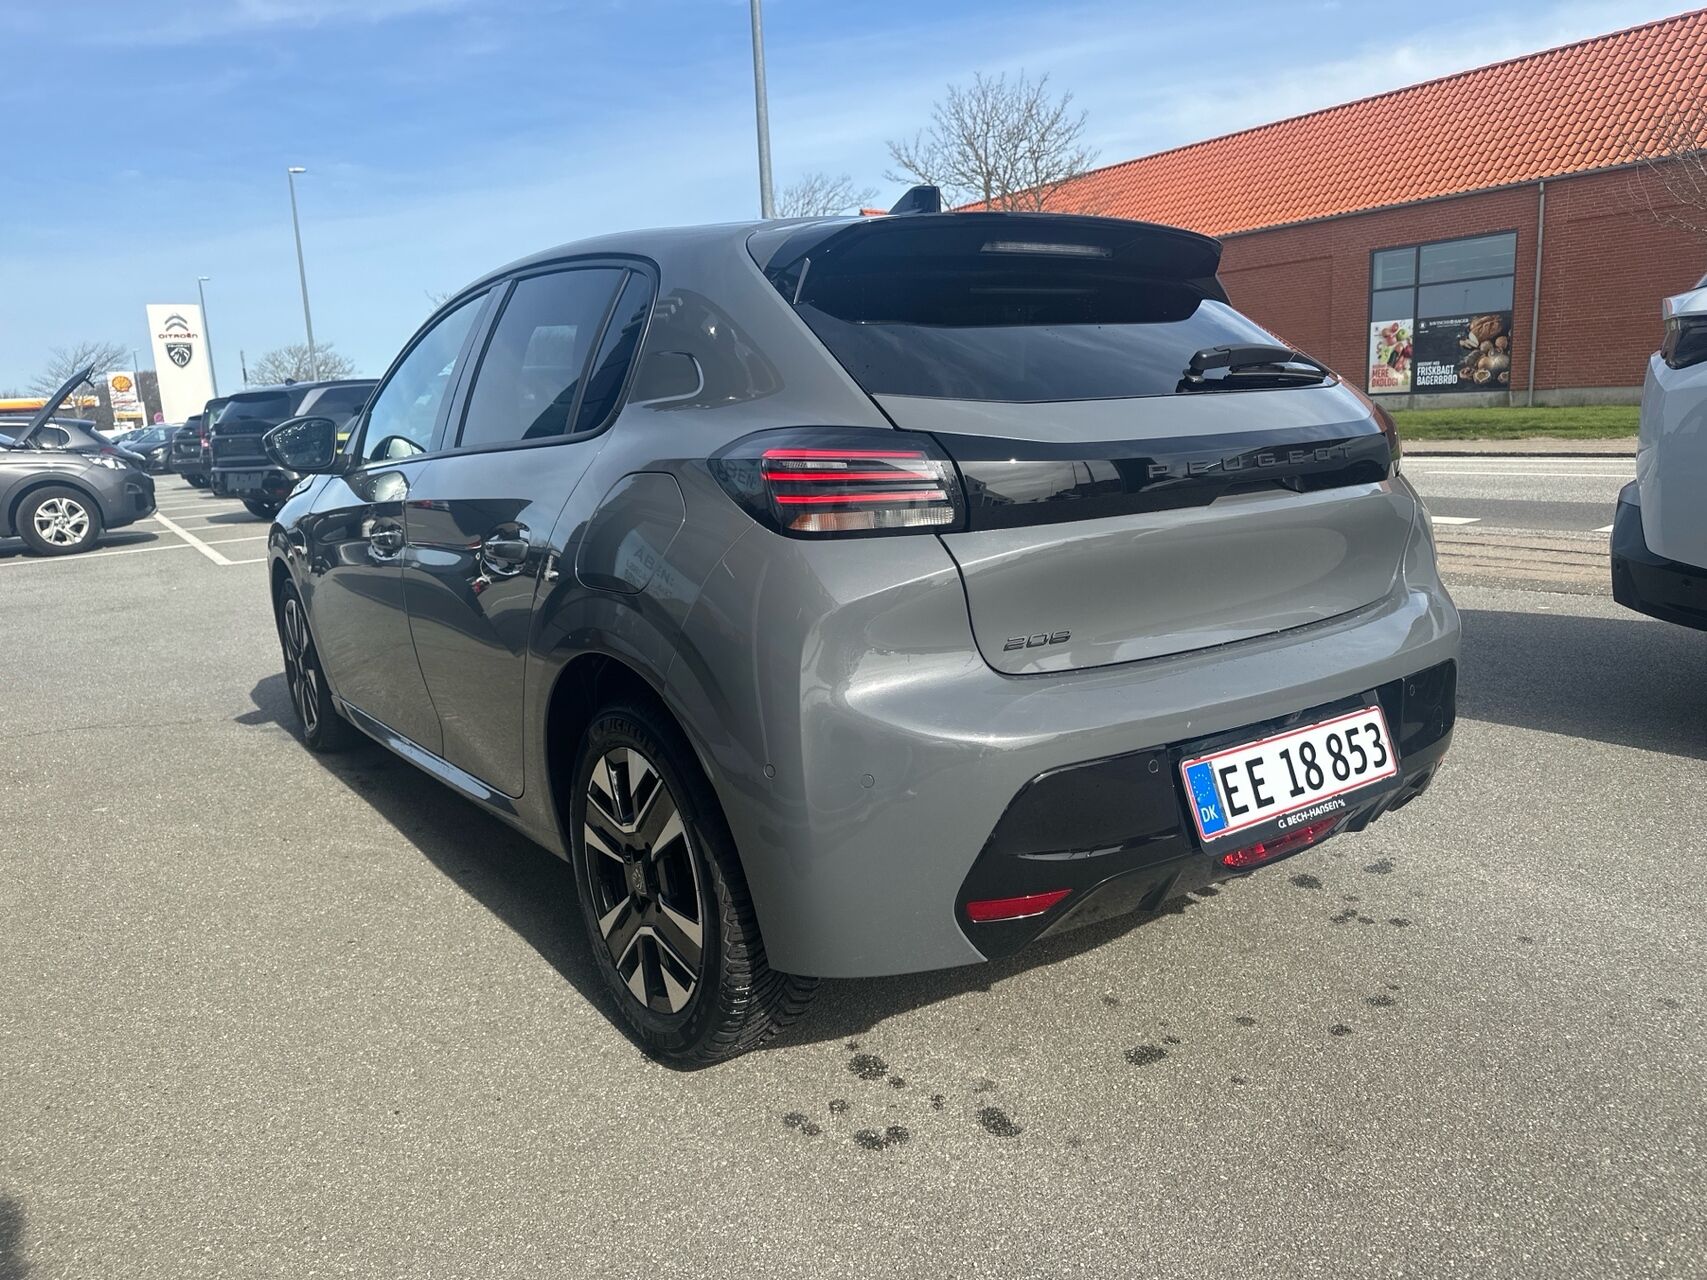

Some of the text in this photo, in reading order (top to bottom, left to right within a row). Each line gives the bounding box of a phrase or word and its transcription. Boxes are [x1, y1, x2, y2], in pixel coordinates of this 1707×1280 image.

[1372, 368, 1389, 378] MERE
[1417, 365, 1455, 376] FRISKBAGT
[1416, 375, 1458, 386] BAGERBRØD
[1148, 445, 1351, 479] PEUGEOT
[1003, 630, 1071, 652] 208
[1219, 722, 1387, 817] EE 18 853
[1201, 806, 1219, 823] DK
[1286, 800, 1339, 826] BECH-HANSEN
